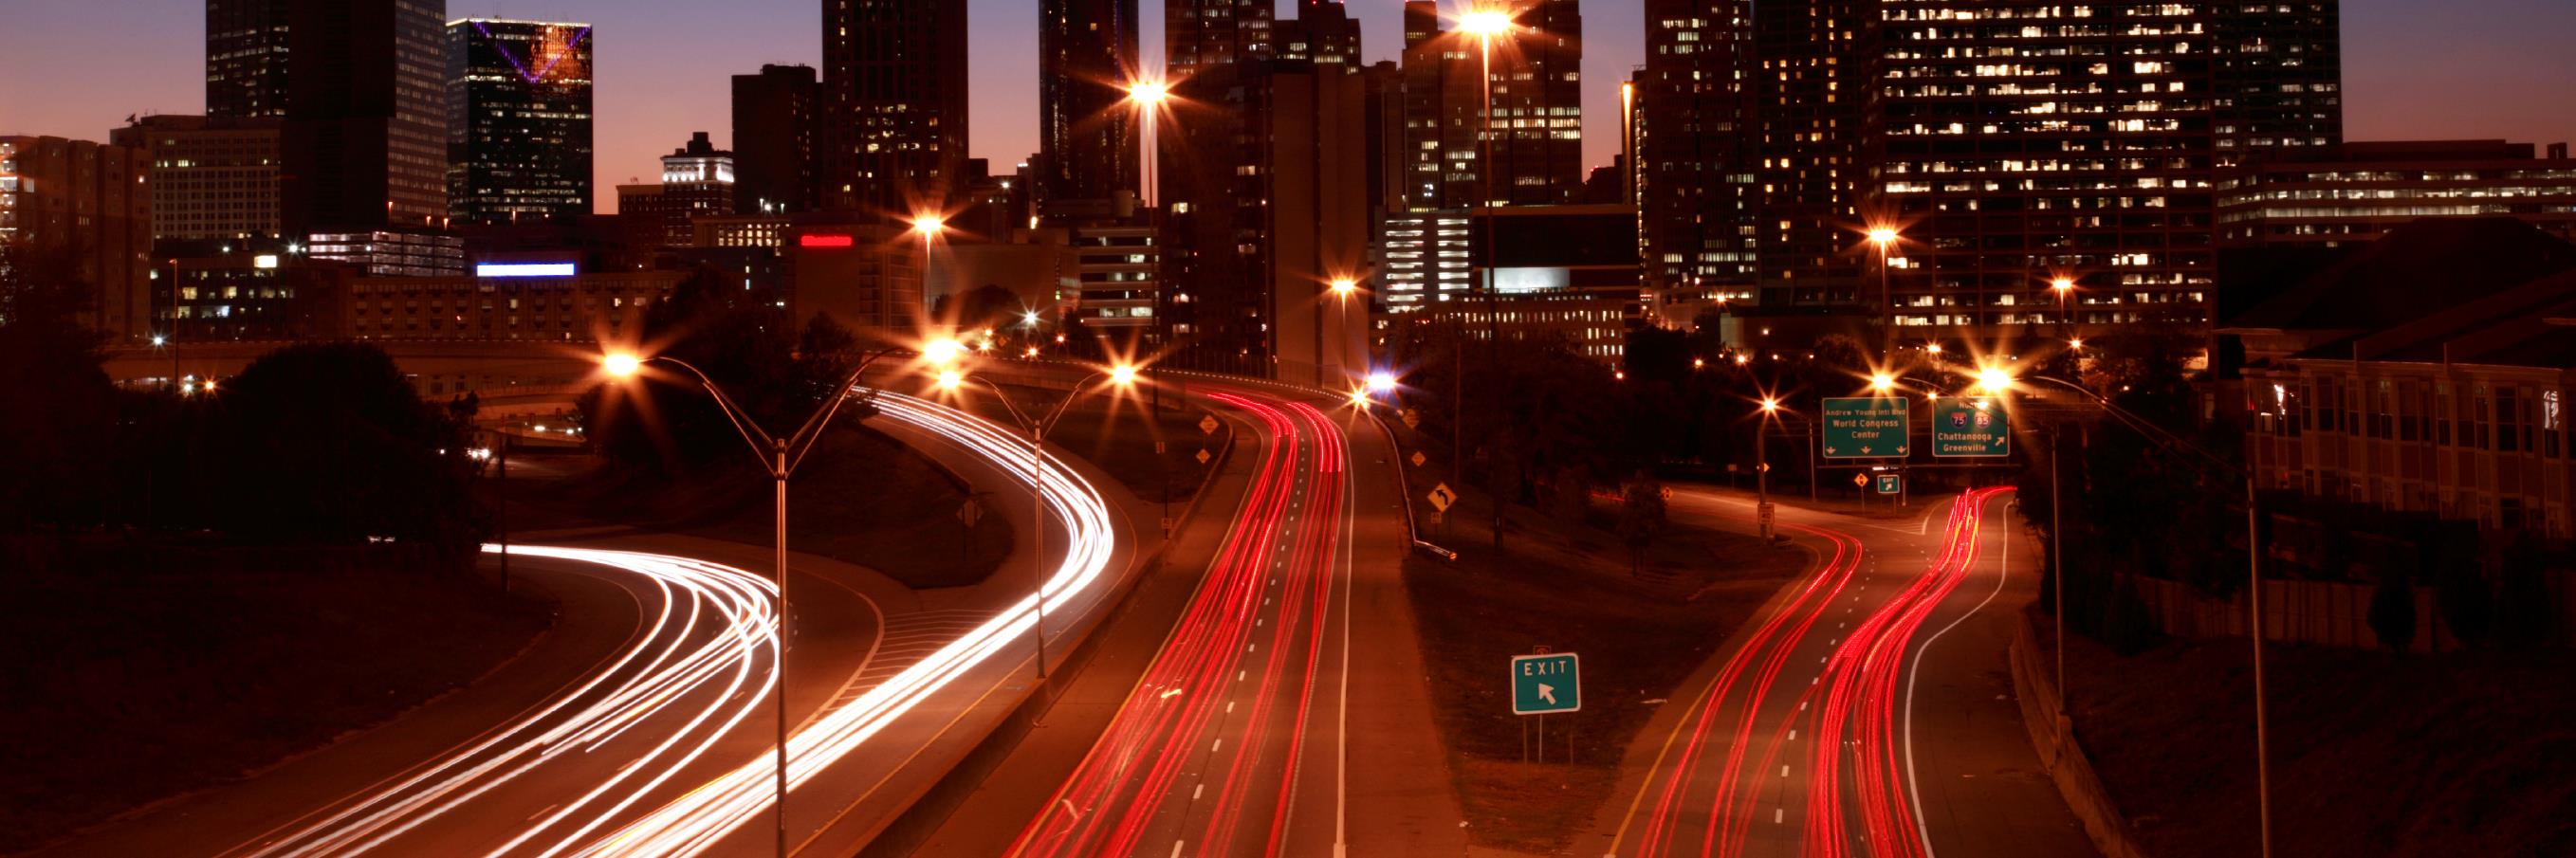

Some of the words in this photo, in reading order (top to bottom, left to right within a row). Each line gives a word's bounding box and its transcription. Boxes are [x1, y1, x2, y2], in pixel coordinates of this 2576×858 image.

[1860, 420, 1899, 429] Congress
[1938, 433, 1992, 442] Chattanooga
[1524, 660, 1567, 676] EXIT
